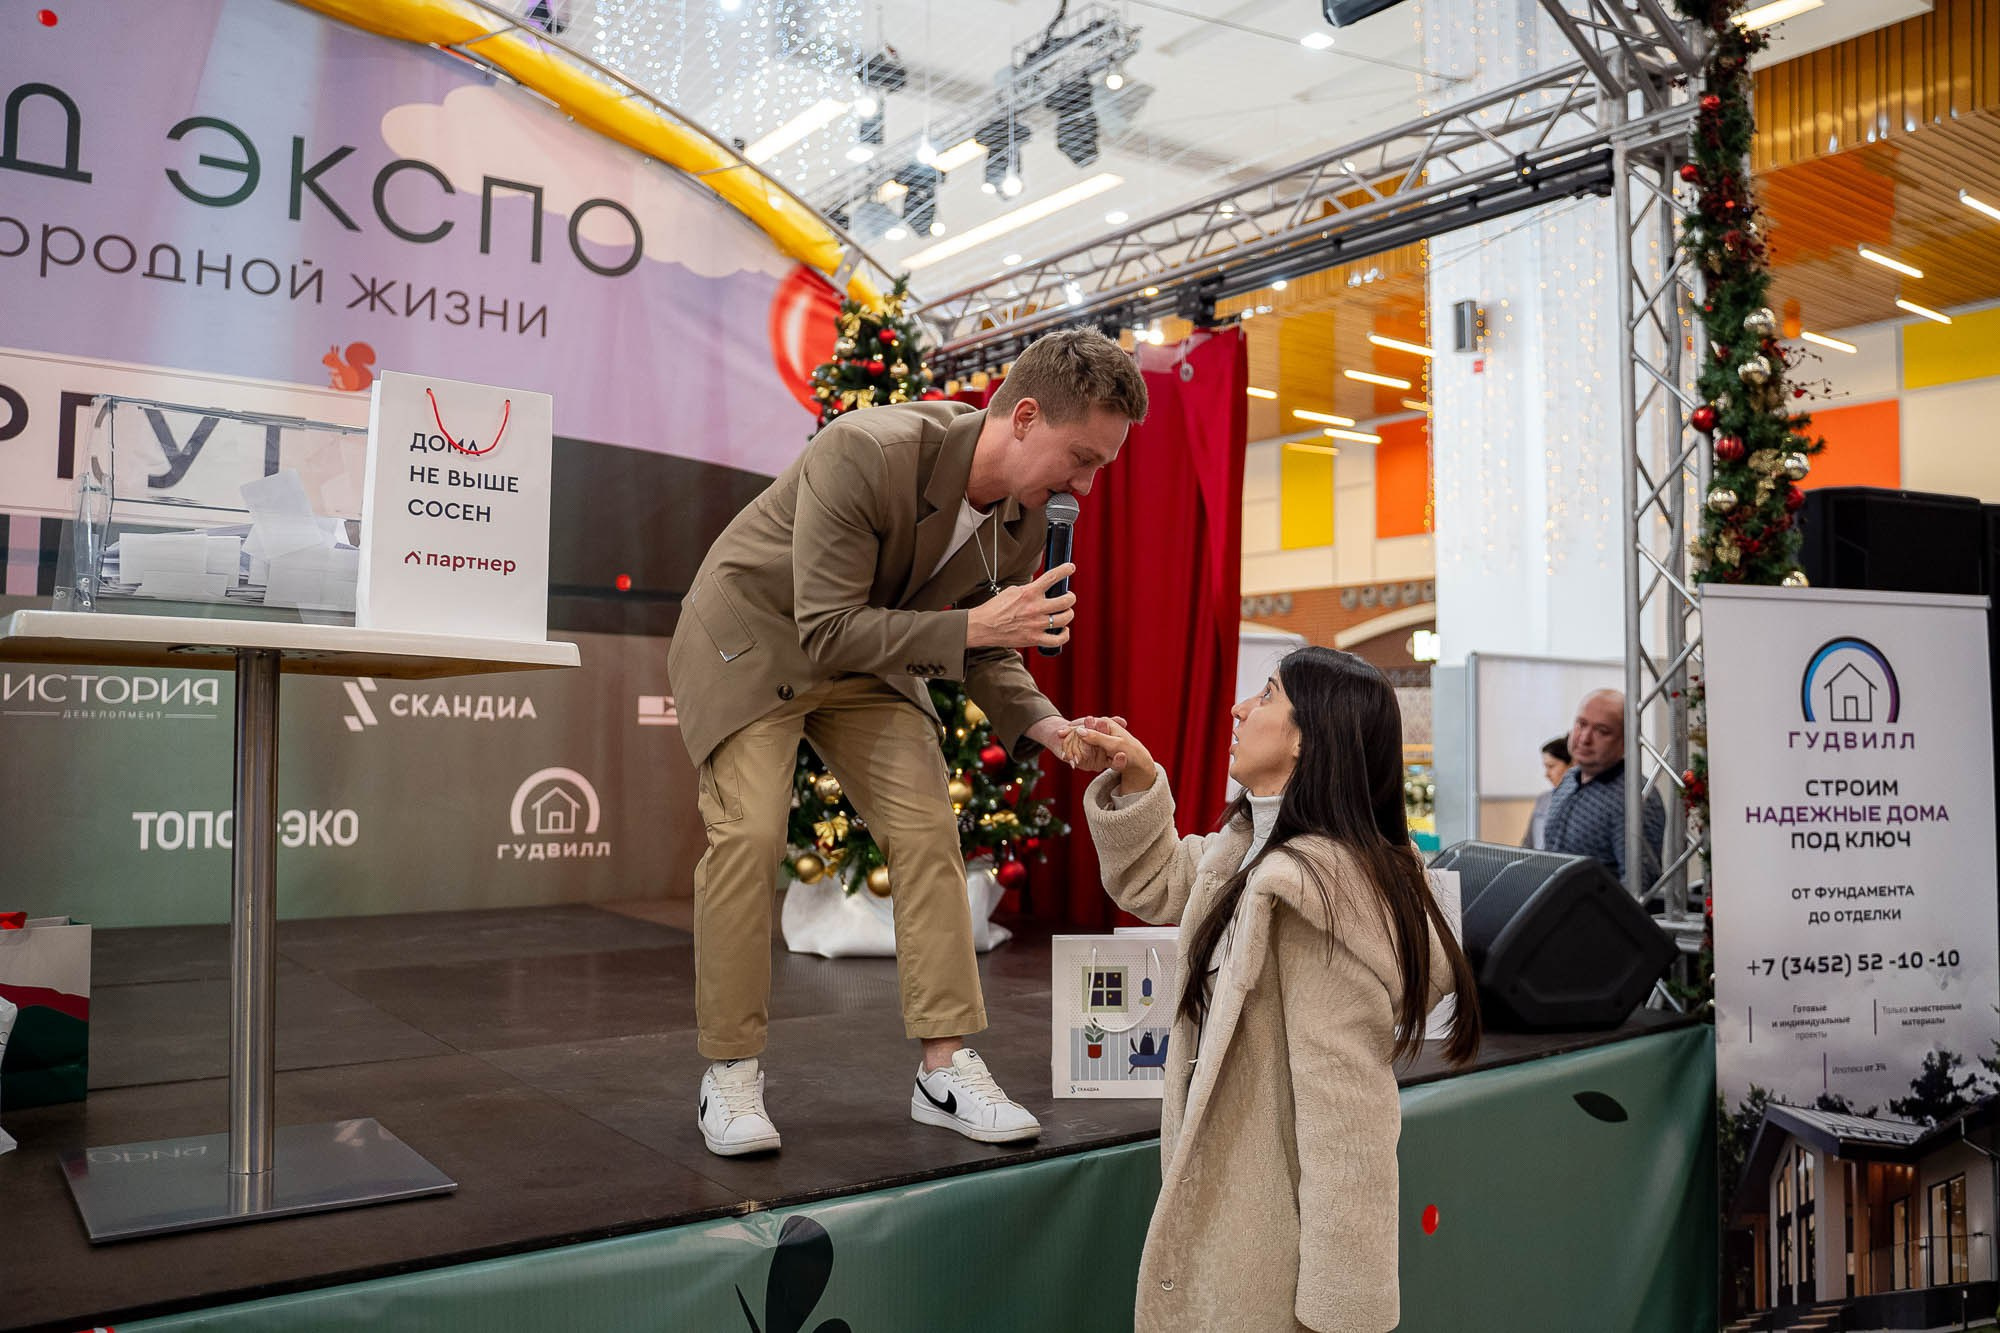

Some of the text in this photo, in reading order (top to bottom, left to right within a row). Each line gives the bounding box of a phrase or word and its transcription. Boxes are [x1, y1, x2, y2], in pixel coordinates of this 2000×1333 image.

[165, 115, 644, 277] ЭКСПО
[346, 273, 548, 337] жизни
[410, 432, 480, 456] ДОМА
[410, 465, 519, 493] НЕ ВЫШЕ
[408, 499, 491, 523] СОСЕН
[426, 553, 516, 576] партнер
[3, 672, 219, 706] ИСТОРИЯ
[63, 710, 162, 720] ДЕВЕЛОПМЕНТ
[389, 694, 537, 721] СКАНДИА
[1788, 731, 1916, 752] ГУДВИЛЛ
[1805, 780, 1898, 796] СТРОИМ
[1745, 805, 1949, 826] НАДЕЖНЫЕ ДОМА
[132, 809, 359, 850] ТОПОЭКО
[497, 841, 611, 860] ГУДВИЛЛ
[1791, 831, 1911, 852] ПОД КЛЮЧ
[1791, 885, 1915, 900] ОТ ФУНДАМЕНТА
[1808, 909, 1902, 925] ДО ОТДЕЛКИ
[1747, 957, 1775, 976] +7
[1781, 953, 1851, 980] (3452)
[1792, 1004, 1827, 1013] Готовые
[1909, 1002, 1962, 1013] качественные
[1779, 1016, 1850, 1029] индивидуальные
[1901, 1017, 1945, 1027] материалы
